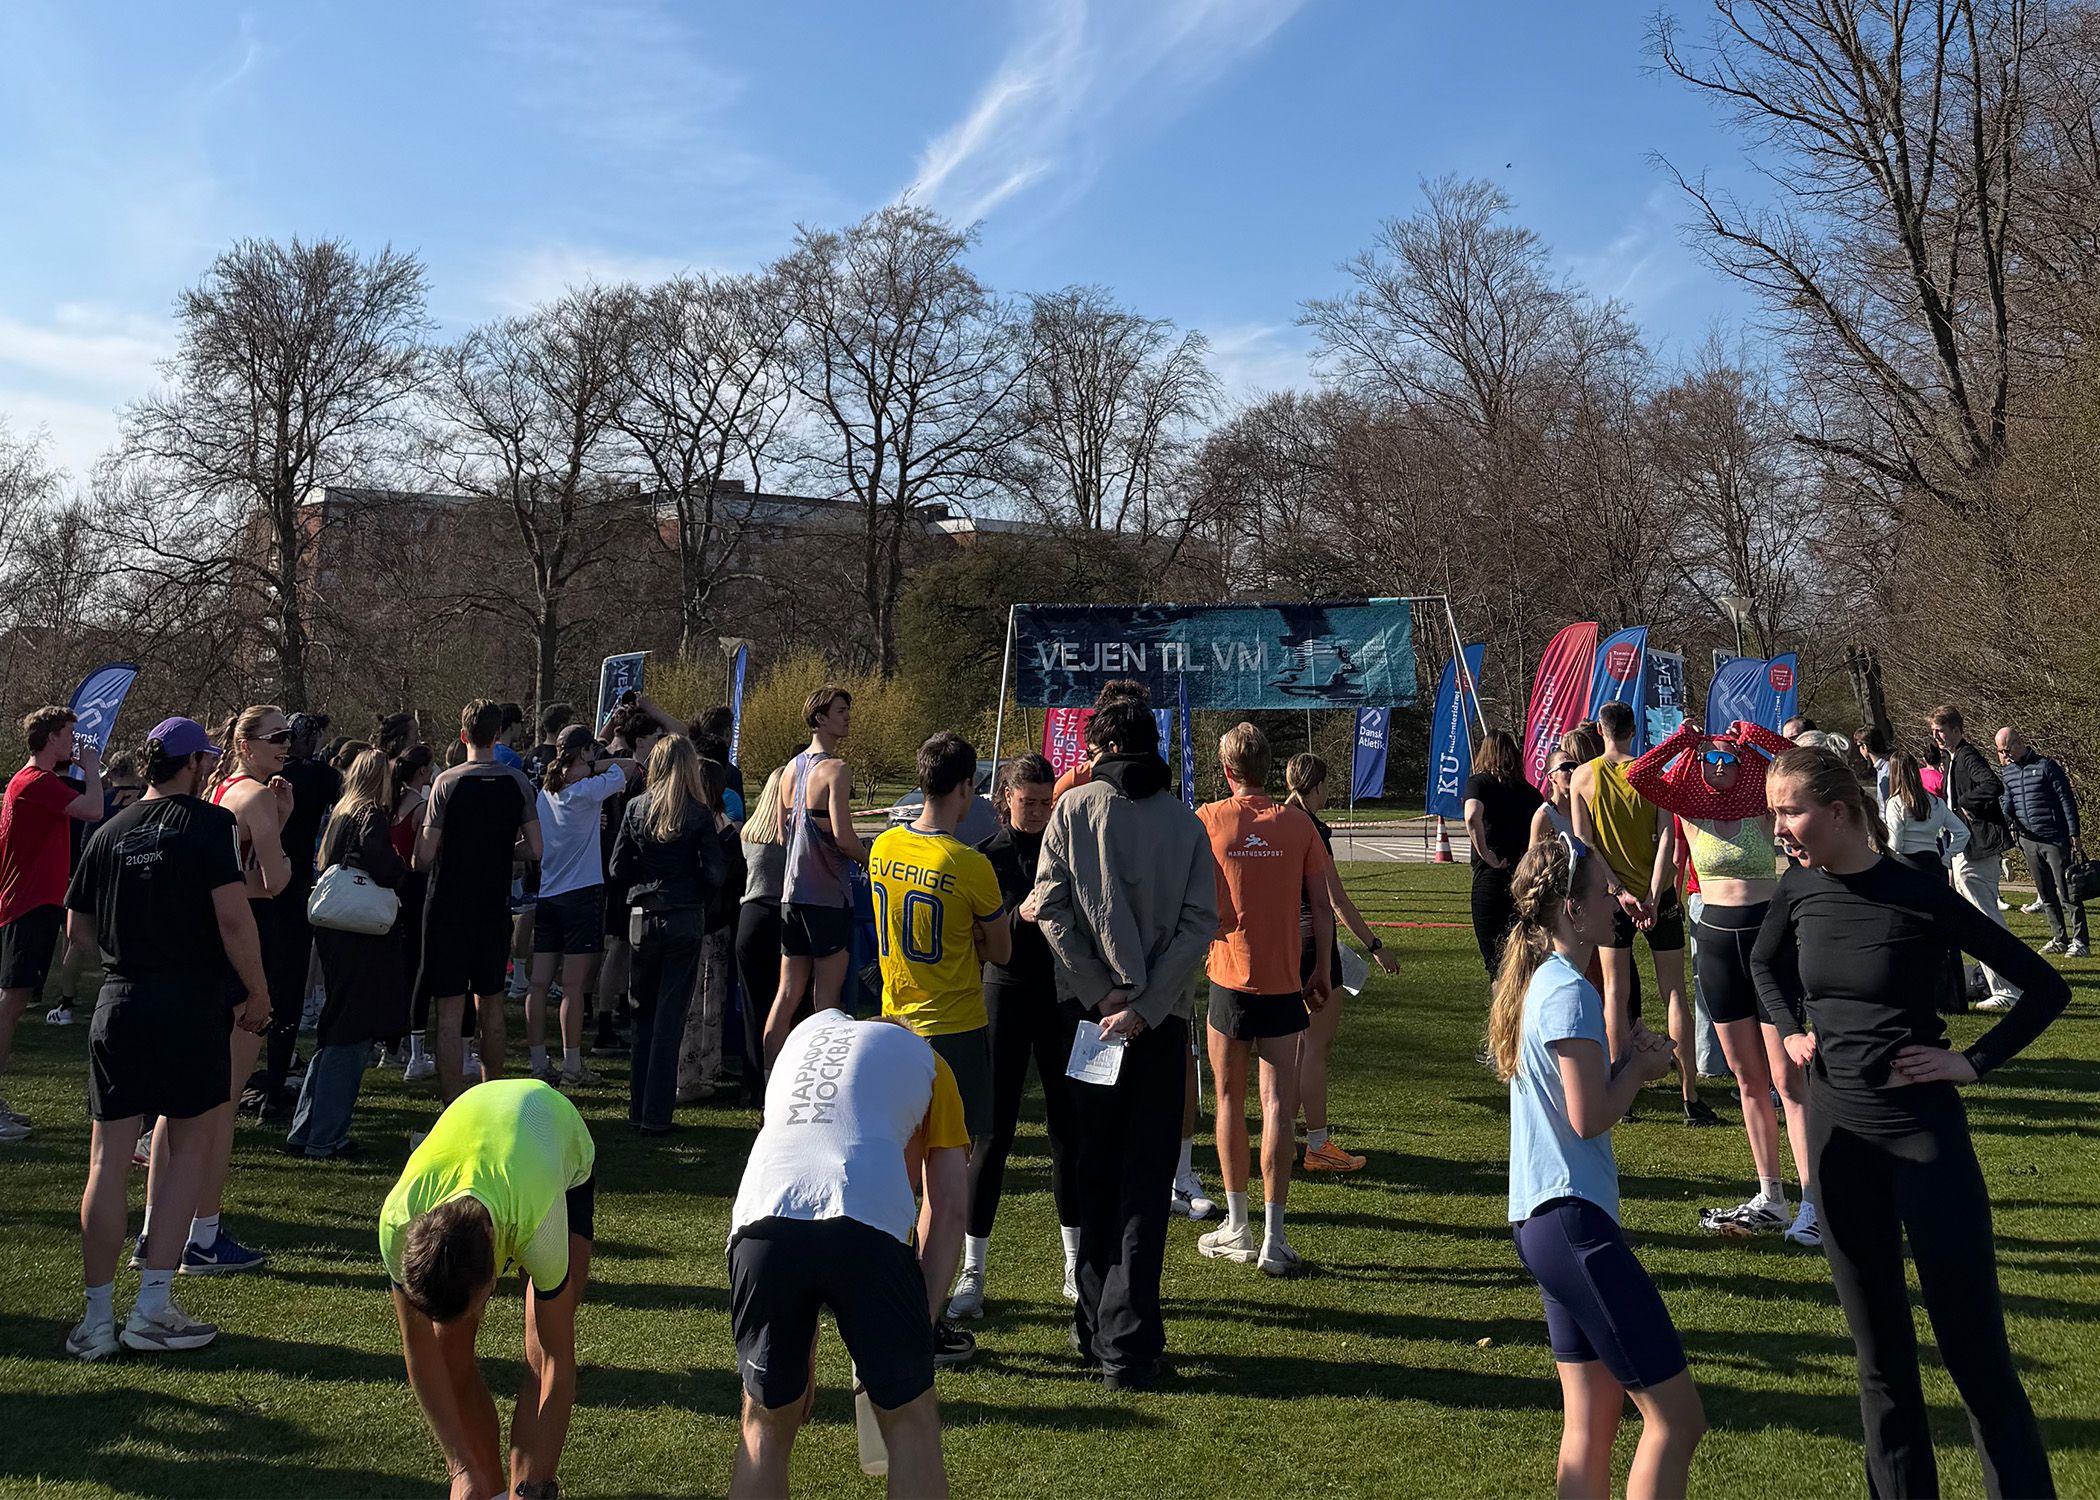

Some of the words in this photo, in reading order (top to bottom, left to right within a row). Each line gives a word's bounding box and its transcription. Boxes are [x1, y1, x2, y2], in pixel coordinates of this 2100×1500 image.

[1036, 642, 1147, 672] VEJEN
[1154, 642, 1205, 672] TIL
[1211, 642, 1269, 671] VM
[73, 731, 100, 745] ansk
[1052, 708, 1068, 777] COPENHA
[1064, 714, 1078, 770] TUDENT
[1360, 725, 1383, 739] Dansk
[1437, 752, 1460, 797] KU
[872, 857, 957, 894] SVERIGE
[873, 881, 944, 964] 10
[786, 1026, 836, 1126] МАРАФОН
